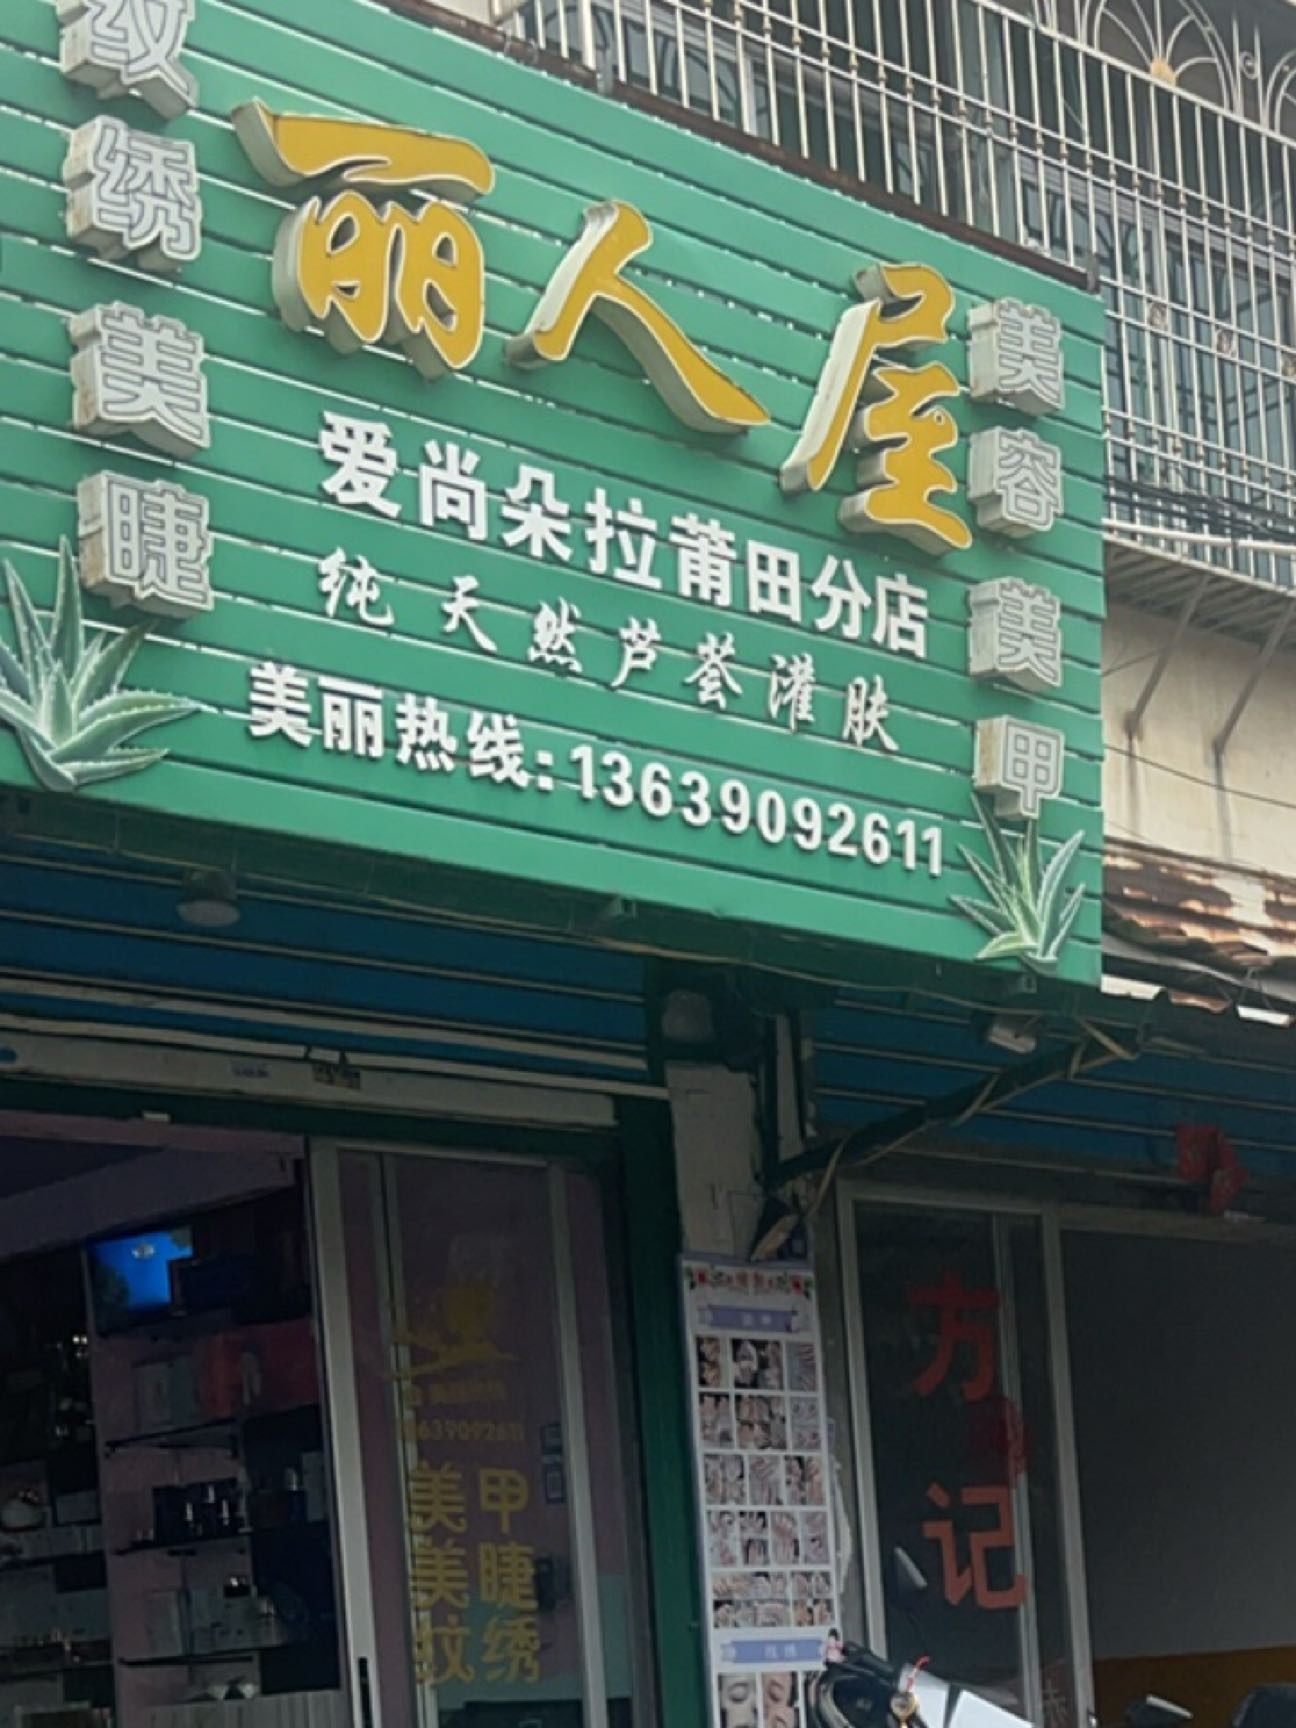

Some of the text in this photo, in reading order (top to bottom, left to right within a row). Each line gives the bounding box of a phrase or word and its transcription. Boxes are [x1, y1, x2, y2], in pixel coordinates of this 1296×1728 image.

[236, 98, 972, 552] 丽人屋
[318, 410, 929, 660] 爱尚朵拉莆田分店
[968, 297, 1065, 820] 美容美甲
[318, 546, 899, 753] 纯天然芦荟灌肤
[409, 1461, 530, 1535] 美甲
[410, 1539, 538, 1612] 美睫
